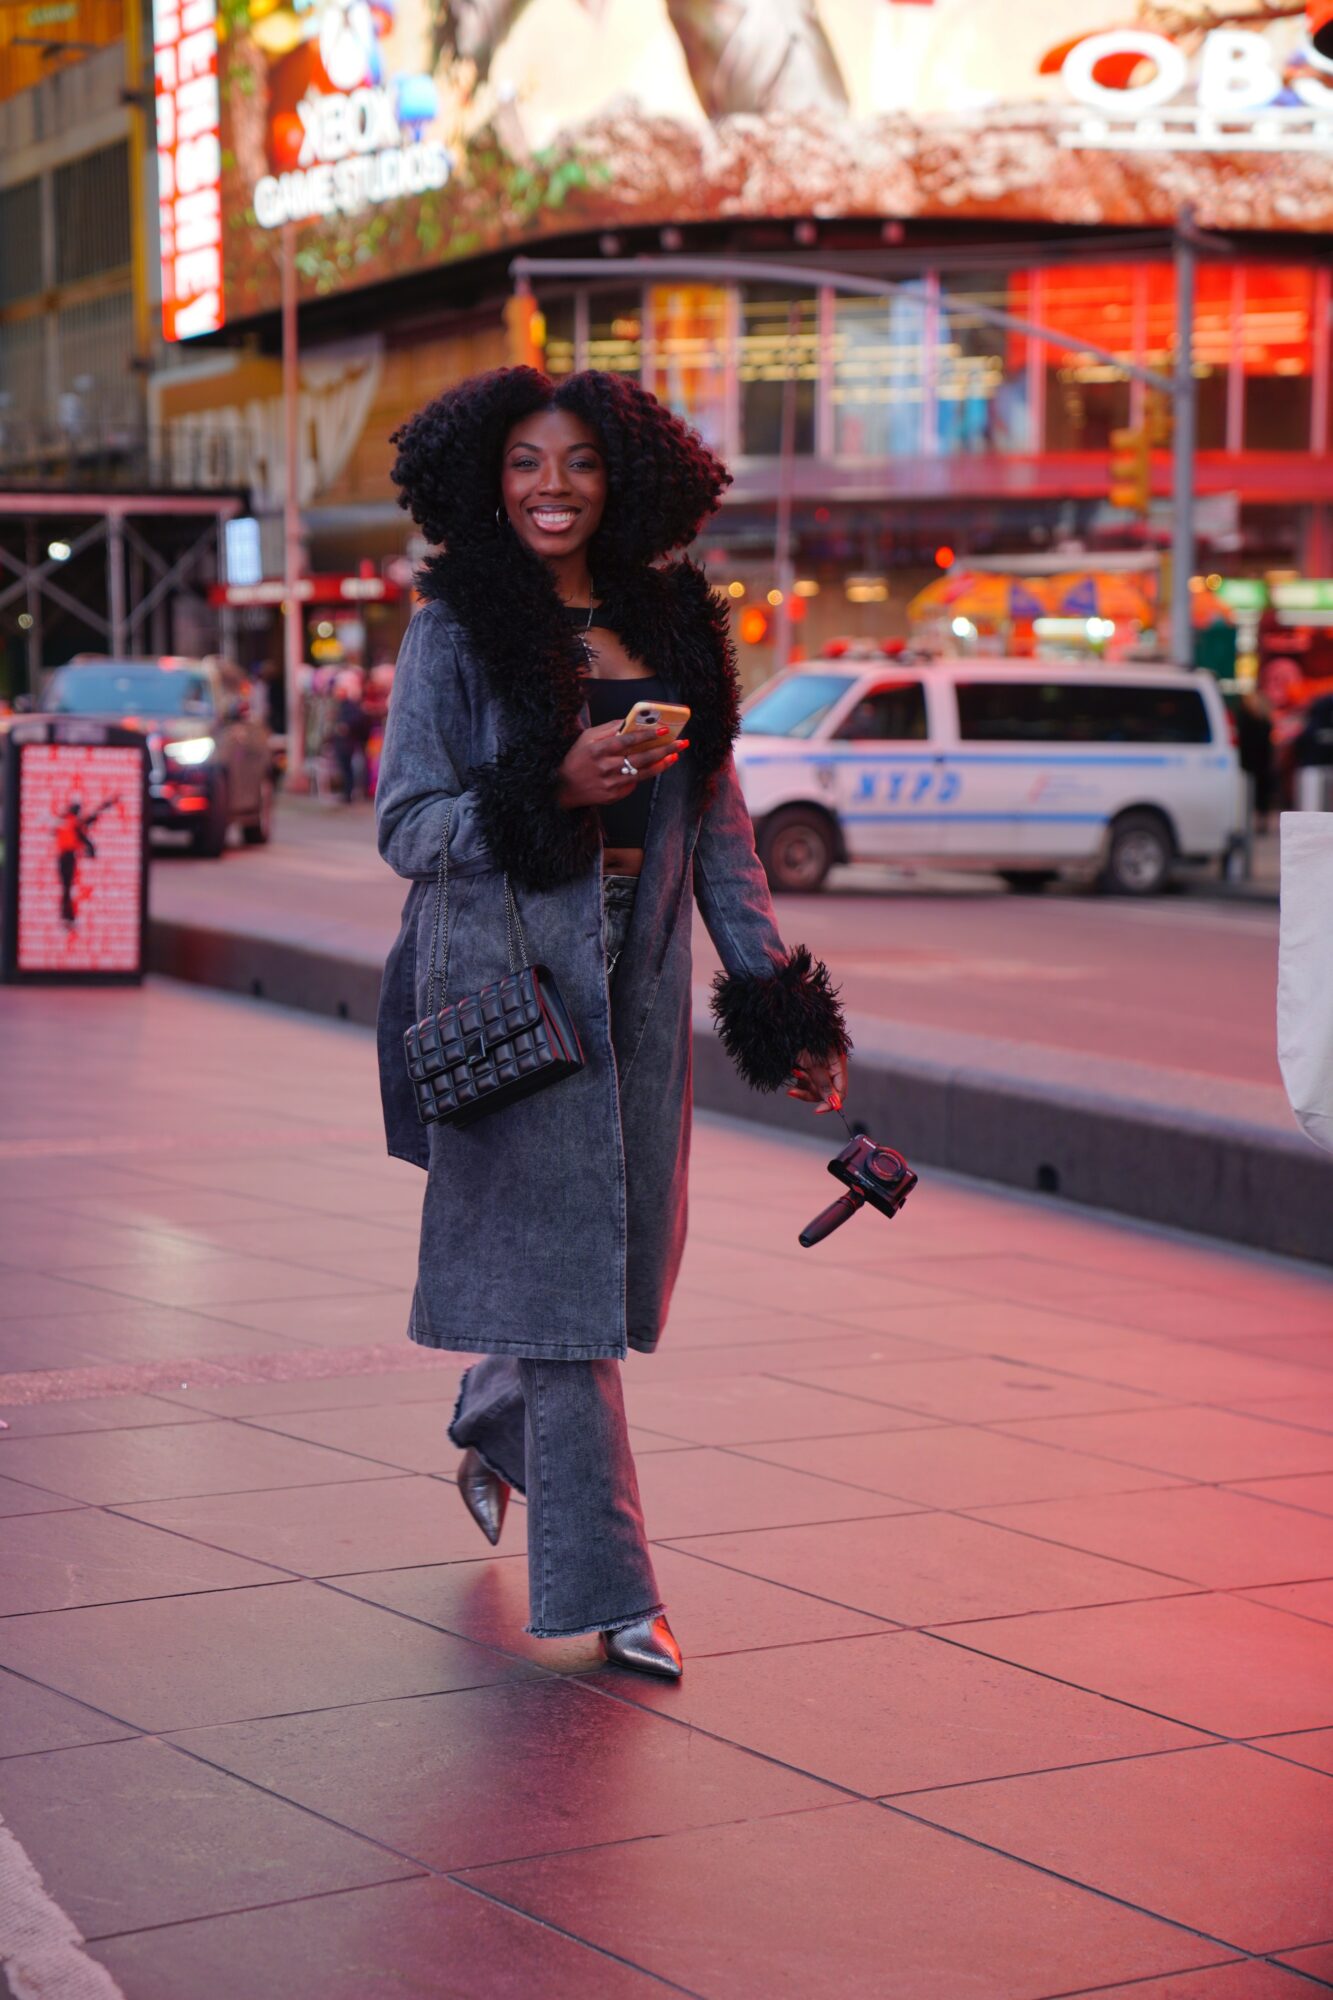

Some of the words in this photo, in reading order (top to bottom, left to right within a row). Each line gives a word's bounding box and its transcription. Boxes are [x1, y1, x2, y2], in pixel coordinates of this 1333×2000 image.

[297, 86, 400, 168] XBOX
[254, 166, 335, 228] GAME
[334, 142, 449, 216] STUDIOS
[853, 770, 962, 804] NYPD
